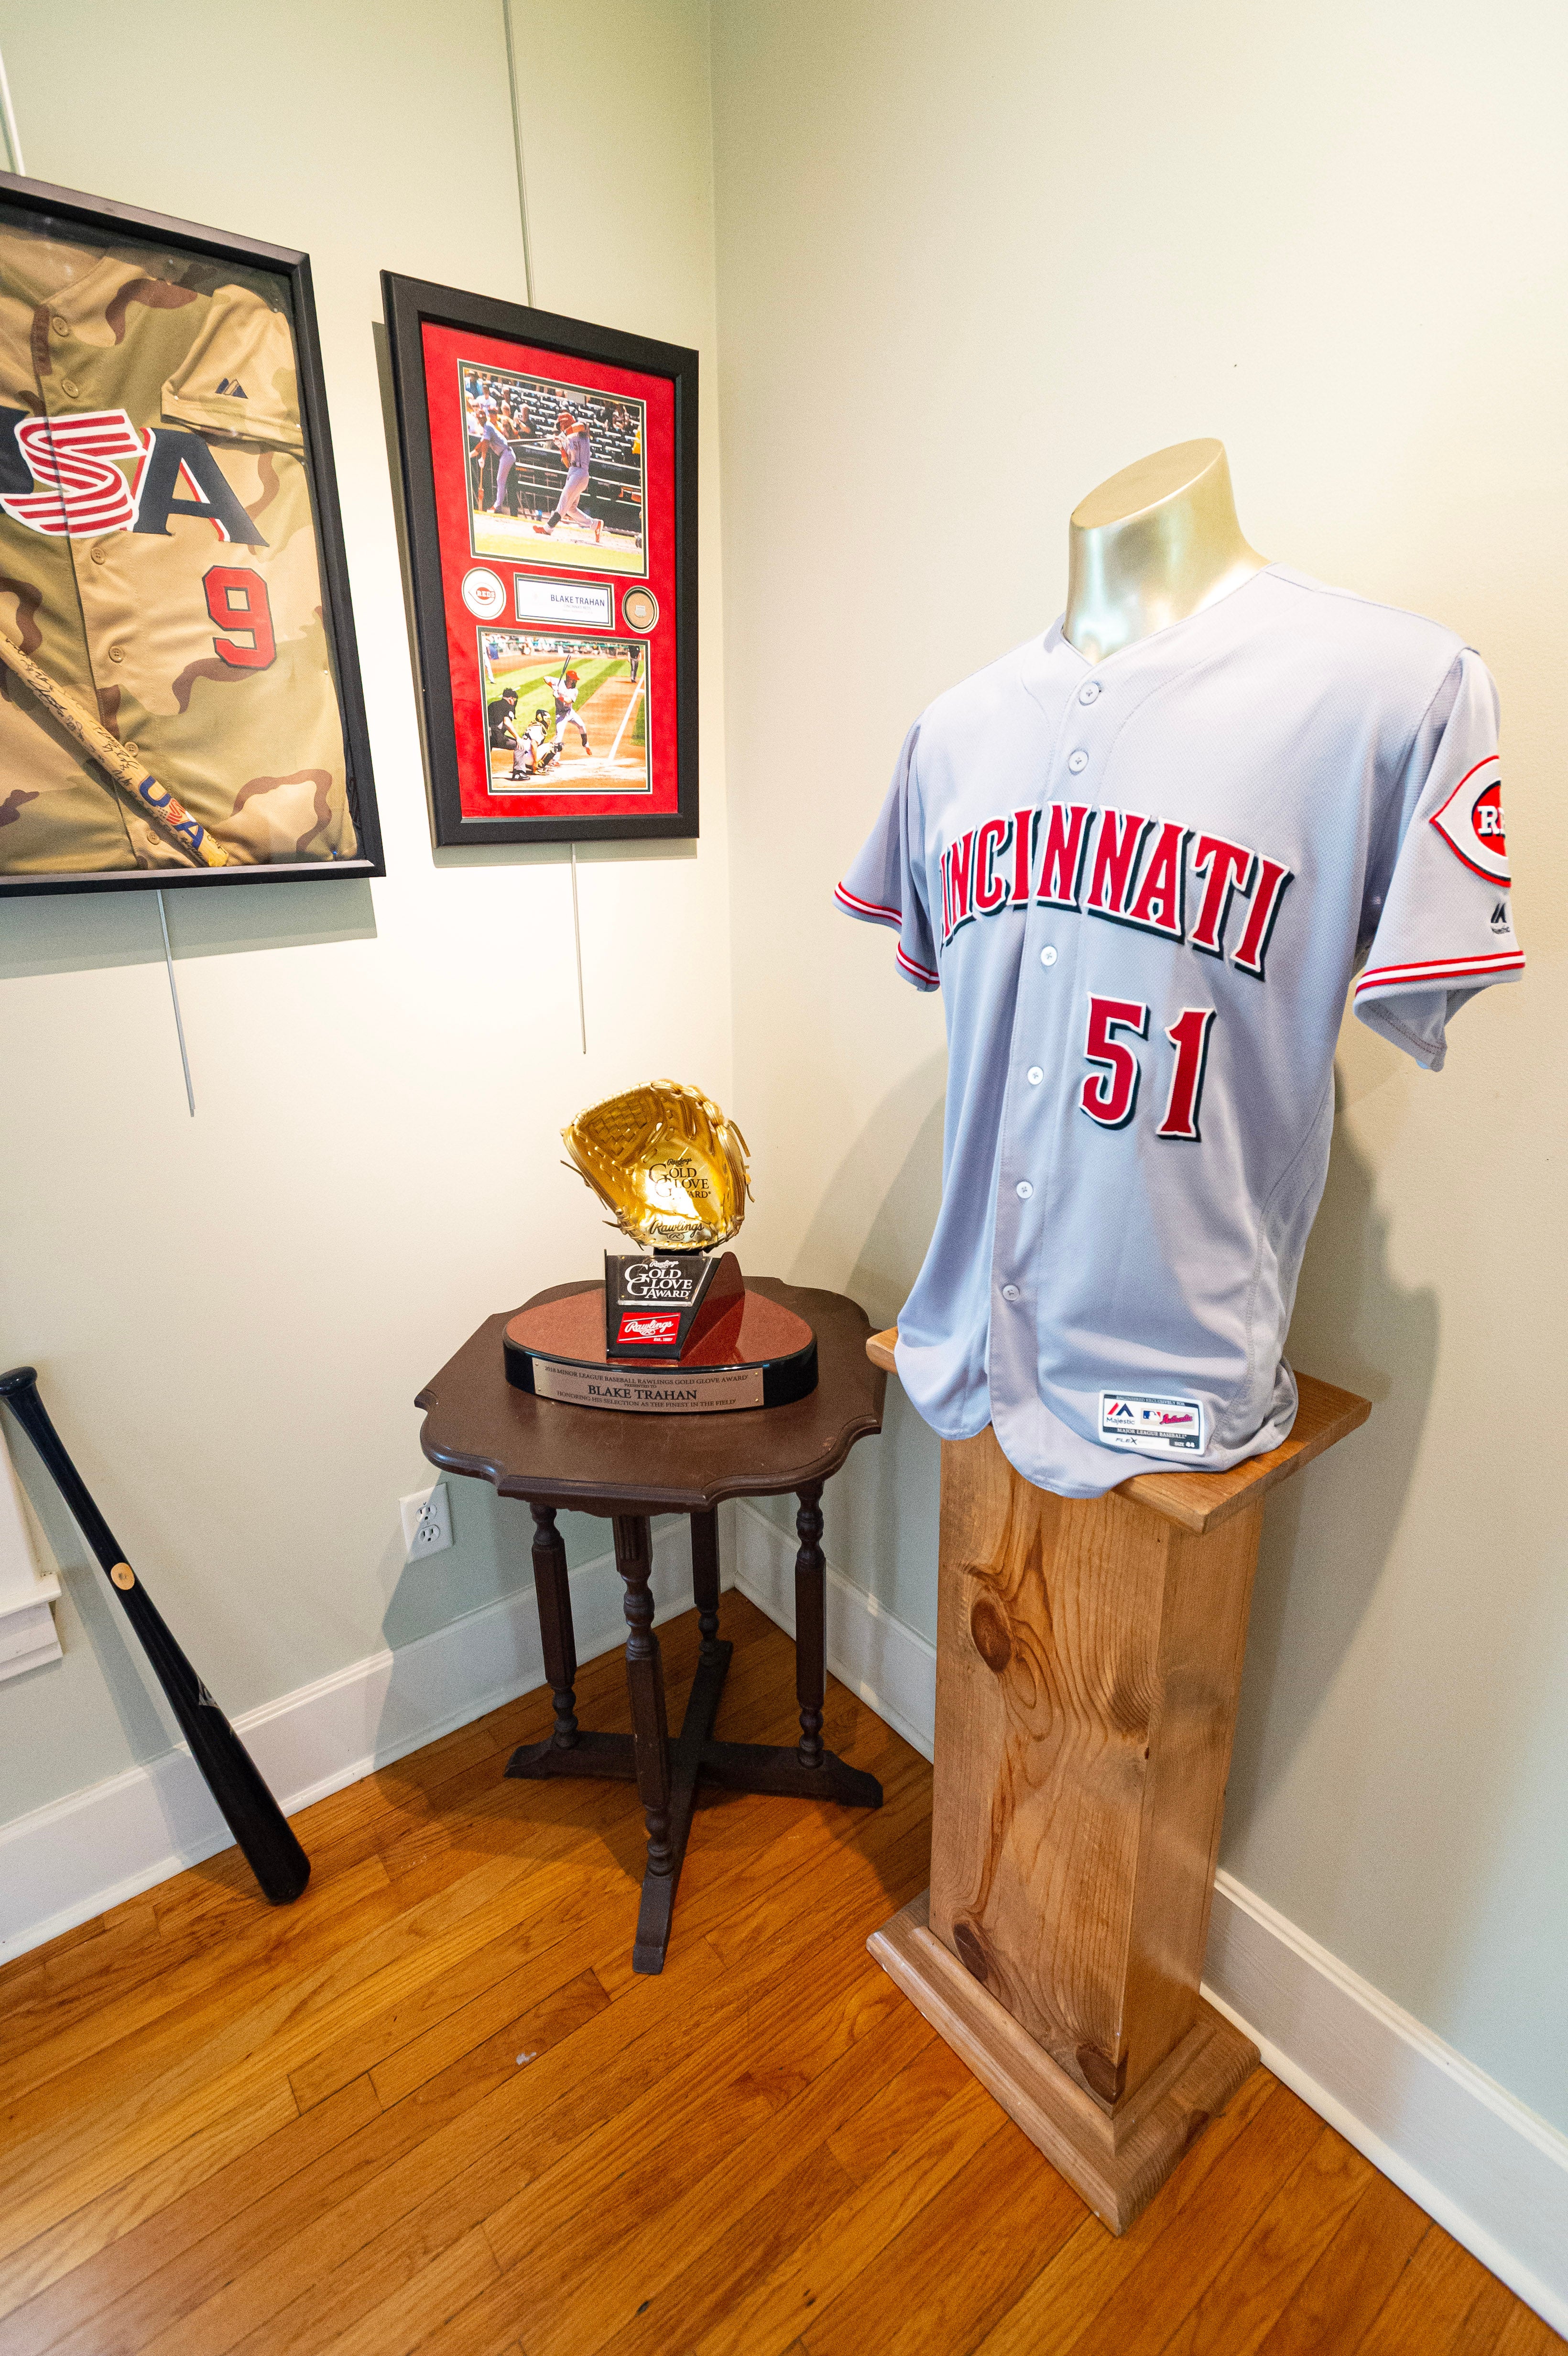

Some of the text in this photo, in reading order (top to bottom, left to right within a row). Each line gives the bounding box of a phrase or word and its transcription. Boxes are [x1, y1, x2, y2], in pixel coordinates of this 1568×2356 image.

[477, 589, 495, 598] REDS
[551, 594, 605, 607] BLAKE TRAHAN
[202, 565, 277, 670] 9
[139, 775, 204, 850] USA
[940, 801, 1294, 982] INCINNATI
[1079, 992, 1217, 1142] 51
[667, 1157, 692, 1166] Rawlings
[649, 1163, 697, 1184] GOLD
[650, 1219, 704, 1238] Rawlings
[649, 1260, 679, 1268] Rawlings
[624, 1264, 682, 1283] GOLD
[627, 1277, 693, 1296] GLOVE
[644, 1288, 689, 1298] AWARD
[624, 1320, 674, 1333] Rawlings
[557, 1369, 577, 1377] MINOR
[579, 1373, 603, 1381] LEAGUE
[557, 1391, 591, 1401] HONORING
[603, 1398, 640, 1407] SELECTION
[588, 1385, 697, 1400] BLAKE TRAHAN
[1106, 1417, 1135, 1425] Majestic
